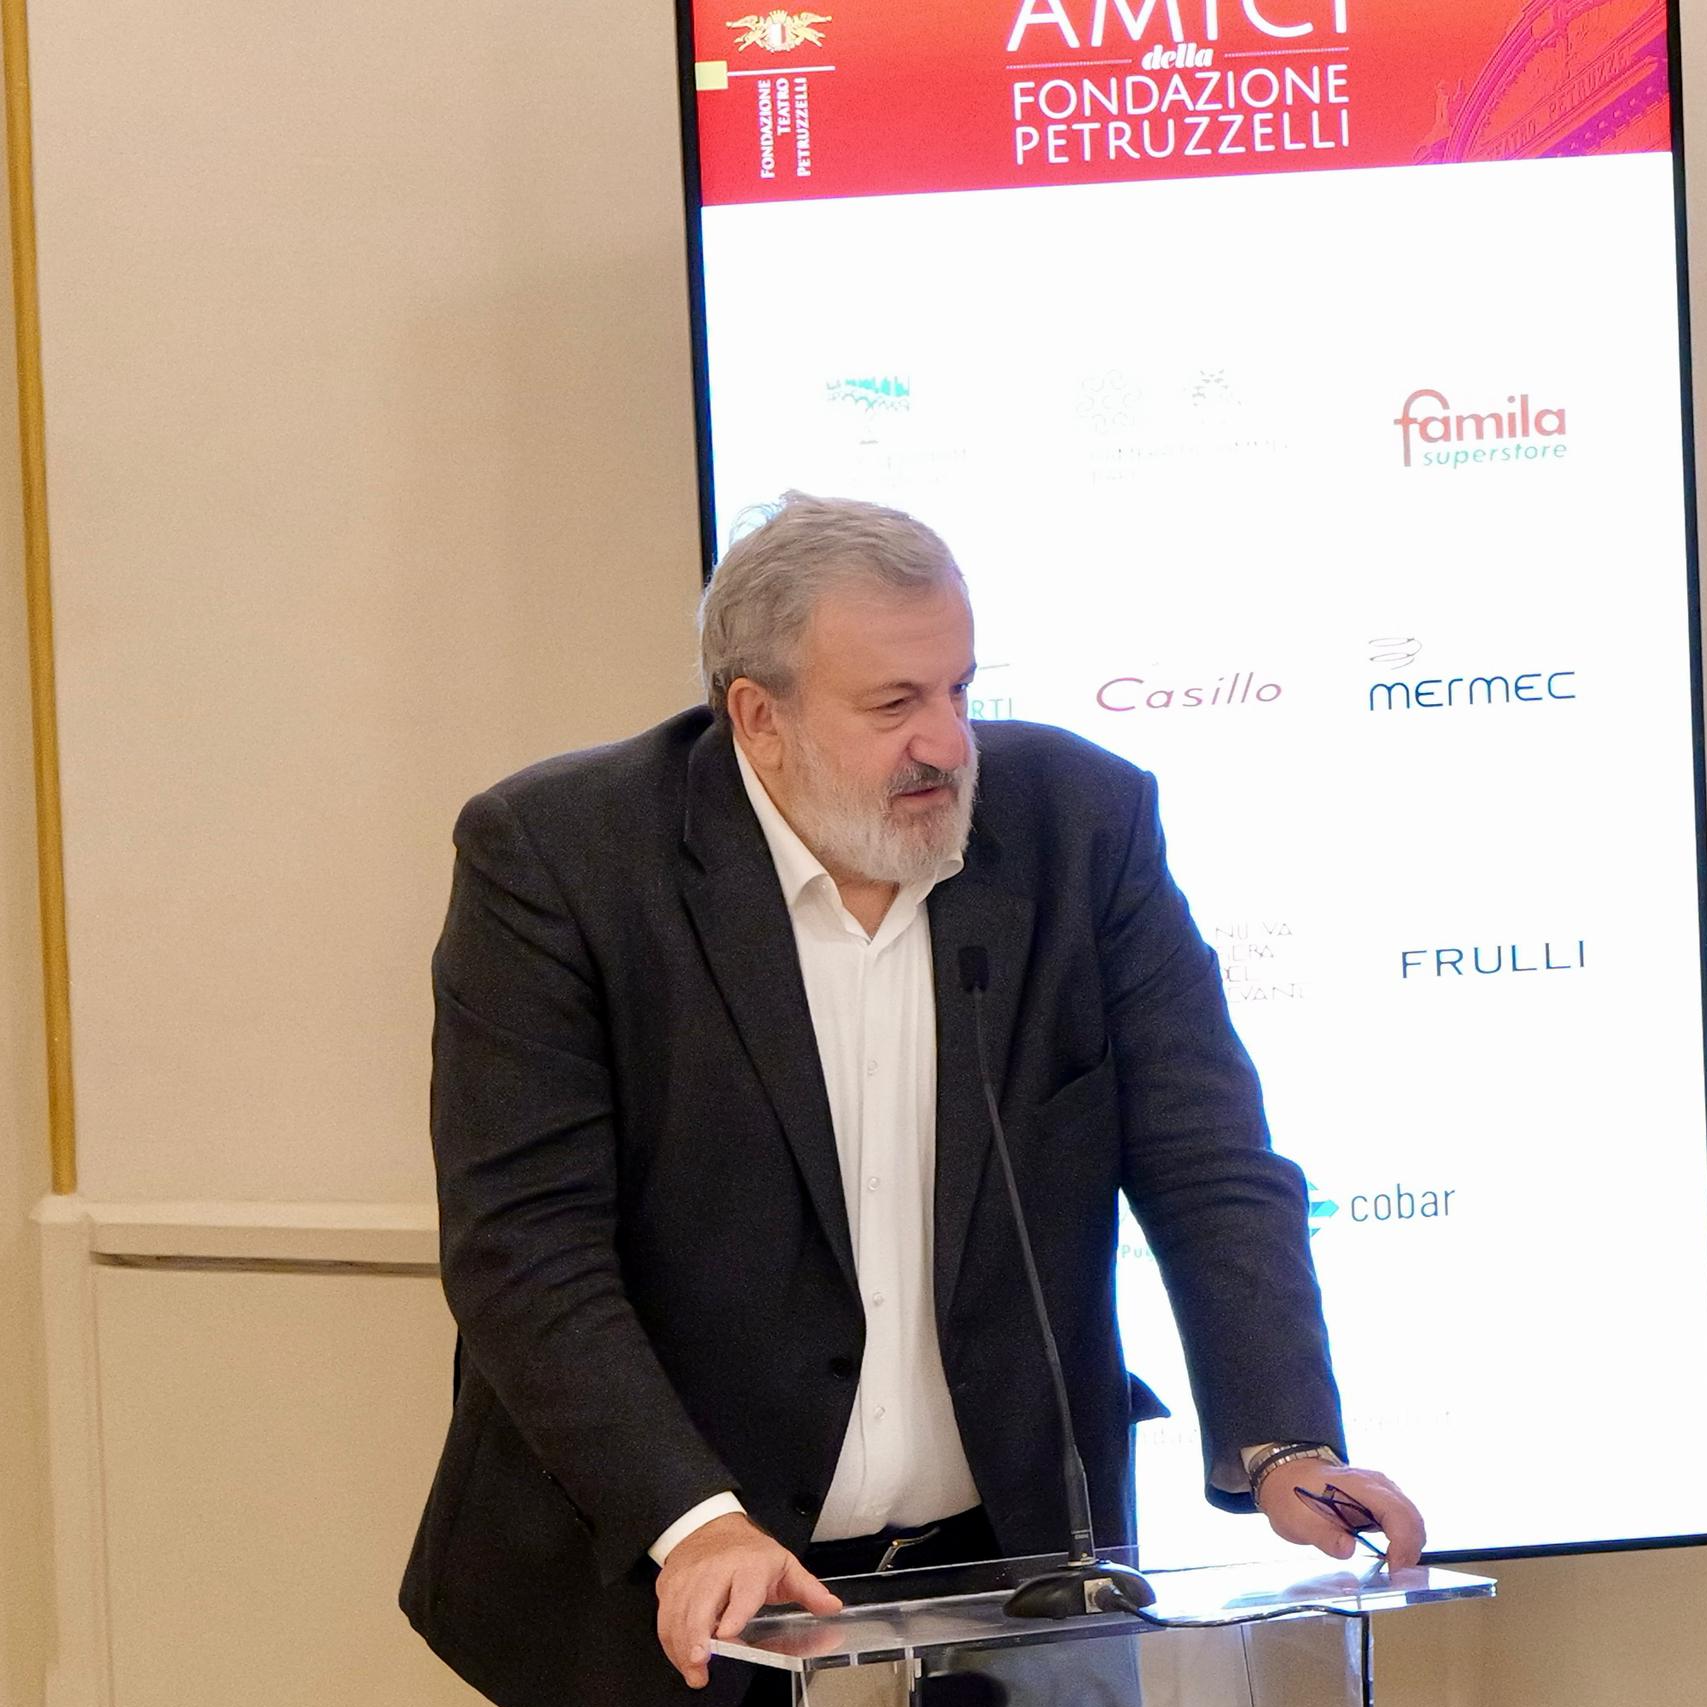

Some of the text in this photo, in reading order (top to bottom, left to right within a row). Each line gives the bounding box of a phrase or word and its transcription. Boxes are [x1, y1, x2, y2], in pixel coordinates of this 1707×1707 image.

[1141, 42, 1214, 71] della
[775, 77, 791, 136] TEATRO
[1013, 64, 1350, 121] FONDAZIONE
[757, 79, 775, 179] FONDAZIONE
[793, 76, 811, 177] PETRUZZELLI
[1015, 108, 1350, 165] PETRUZZELLI
[1394, 388, 1567, 467] famila
[1423, 443, 1567, 469] superstore
[1096, 671, 1282, 711] Casillo
[1401, 940, 1585, 979] FRULLI
[1350, 1183, 1456, 1222] cobar
